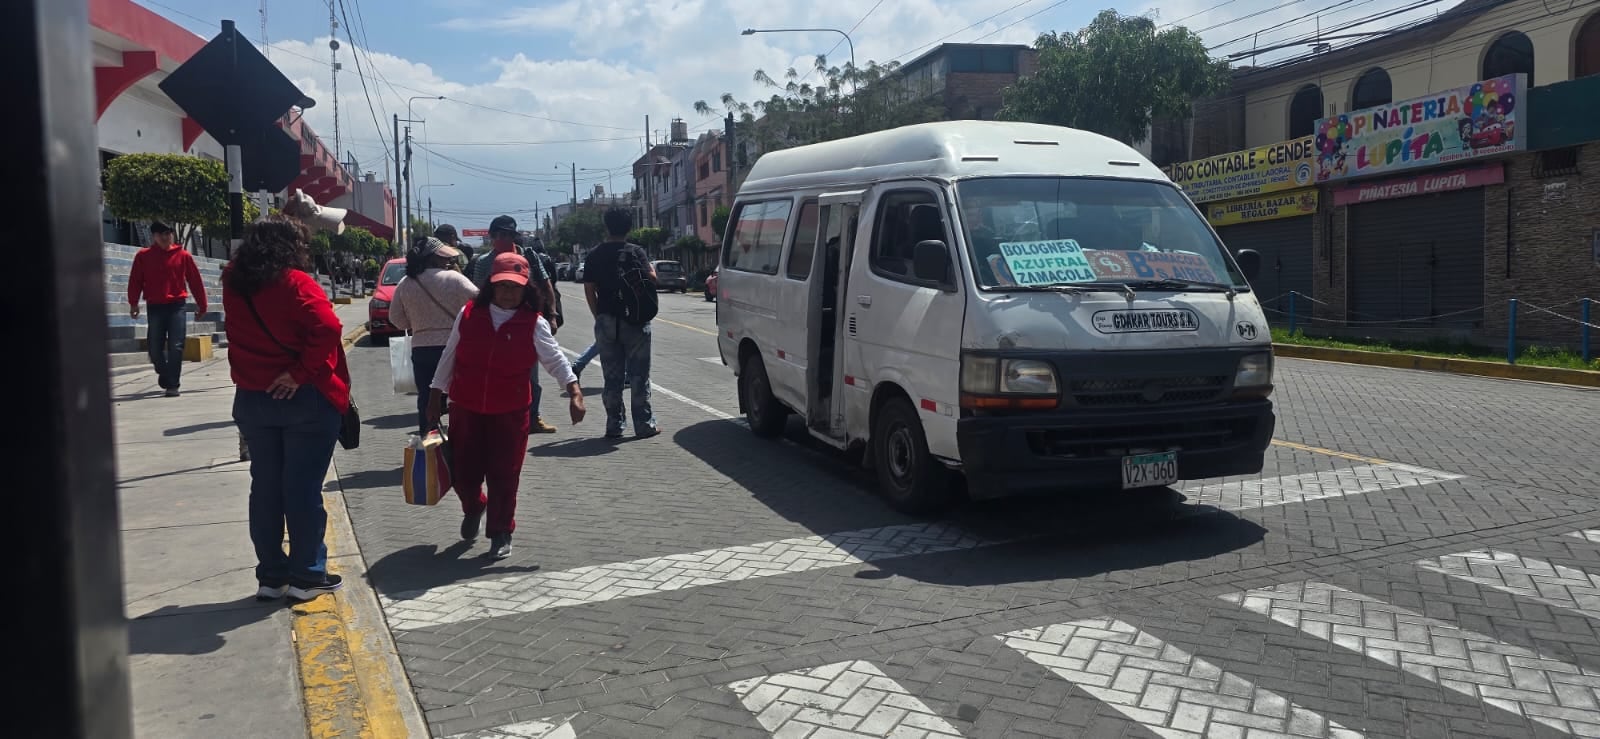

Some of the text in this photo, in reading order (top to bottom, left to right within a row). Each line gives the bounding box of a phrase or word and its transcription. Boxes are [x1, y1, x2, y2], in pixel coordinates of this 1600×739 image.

[1353, 95, 1460, 135] PIÑATERIA
[1163, 162, 1194, 183] TUDIO
[1197, 152, 1256, 179] CONTABLE
[1268, 140, 1312, 166] CENDE
[1224, 173, 1255, 186] CONTABLE
[1423, 174, 1467, 191] LUPITA
[1266, 196, 1296, 209] BAZAR
[1241, 207, 1278, 219] REGALOS
[1002, 241, 1079, 256] BOLOGNESI
[1013, 256, 1088, 270] AZUFRAL
[1016, 268, 1095, 284] ZAMACOLA
[1150, 311, 1178, 328] TOURS
[1125, 461, 1175, 483] V2X-060
